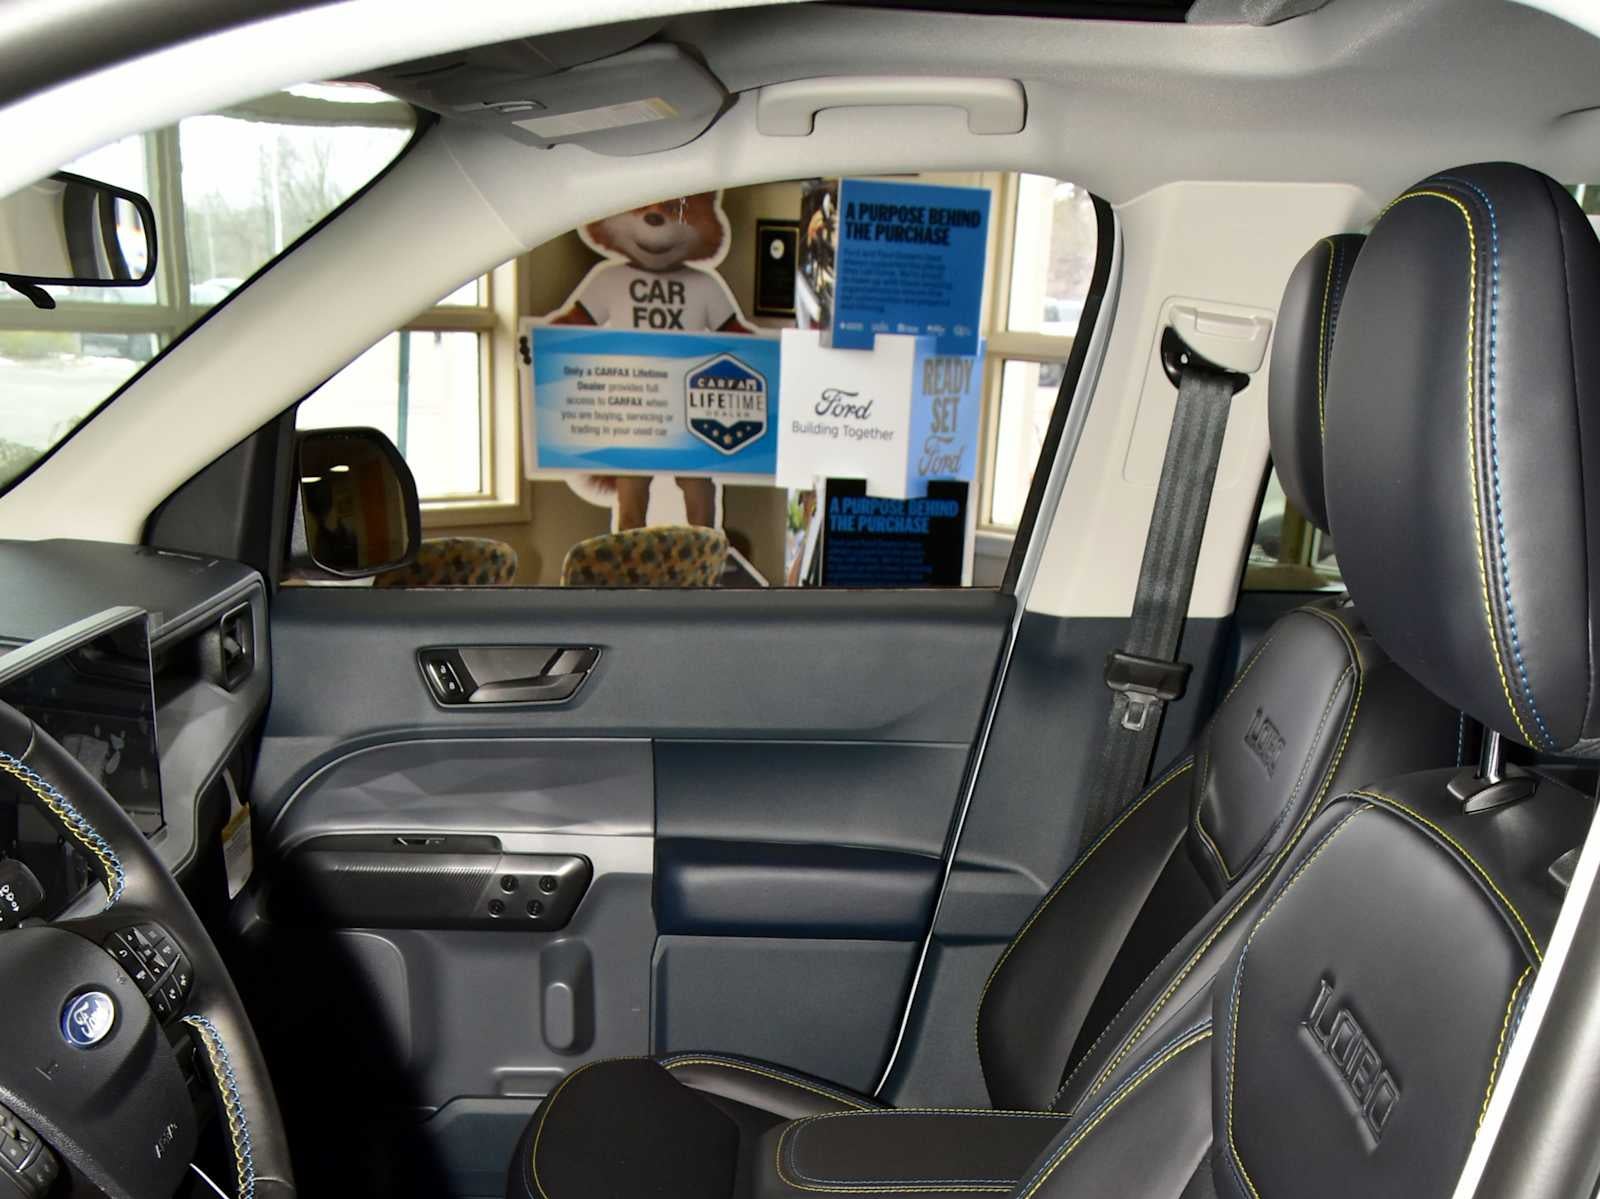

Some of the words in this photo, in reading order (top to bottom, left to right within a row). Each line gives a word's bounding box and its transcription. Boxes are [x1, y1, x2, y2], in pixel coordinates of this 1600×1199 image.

[846, 202, 855, 220] A
[859, 203, 926, 224] PURPOSE
[929, 208, 982, 229] BEHIND
[845, 222, 872, 241] THE
[875, 224, 951, 246] PURCHASE
[629, 279, 686, 304] CAR
[632, 306, 685, 331] FOX
[595, 367, 630, 377] CARFAX
[632, 368, 669, 378] Lifetime
[697, 377, 758, 391] CARFAX
[922, 356, 975, 396] READY
[577, 381, 606, 391] Dealer
[608, 396, 643, 406] CARFAX
[689, 392, 764, 411] LIFETIME
[815, 388, 873, 420] Ford
[931, 397, 961, 433] SET
[792, 421, 840, 439] Building
[843, 424, 894, 441] Together
[917, 435, 966, 476] Ford
[830, 496, 840, 514] A
[843, 497, 906, 514] PURPOSE
[908, 498, 961, 518] BEHIND
[830, 514, 857, 532] THE
[858, 515, 930, 535] PURCHASE
